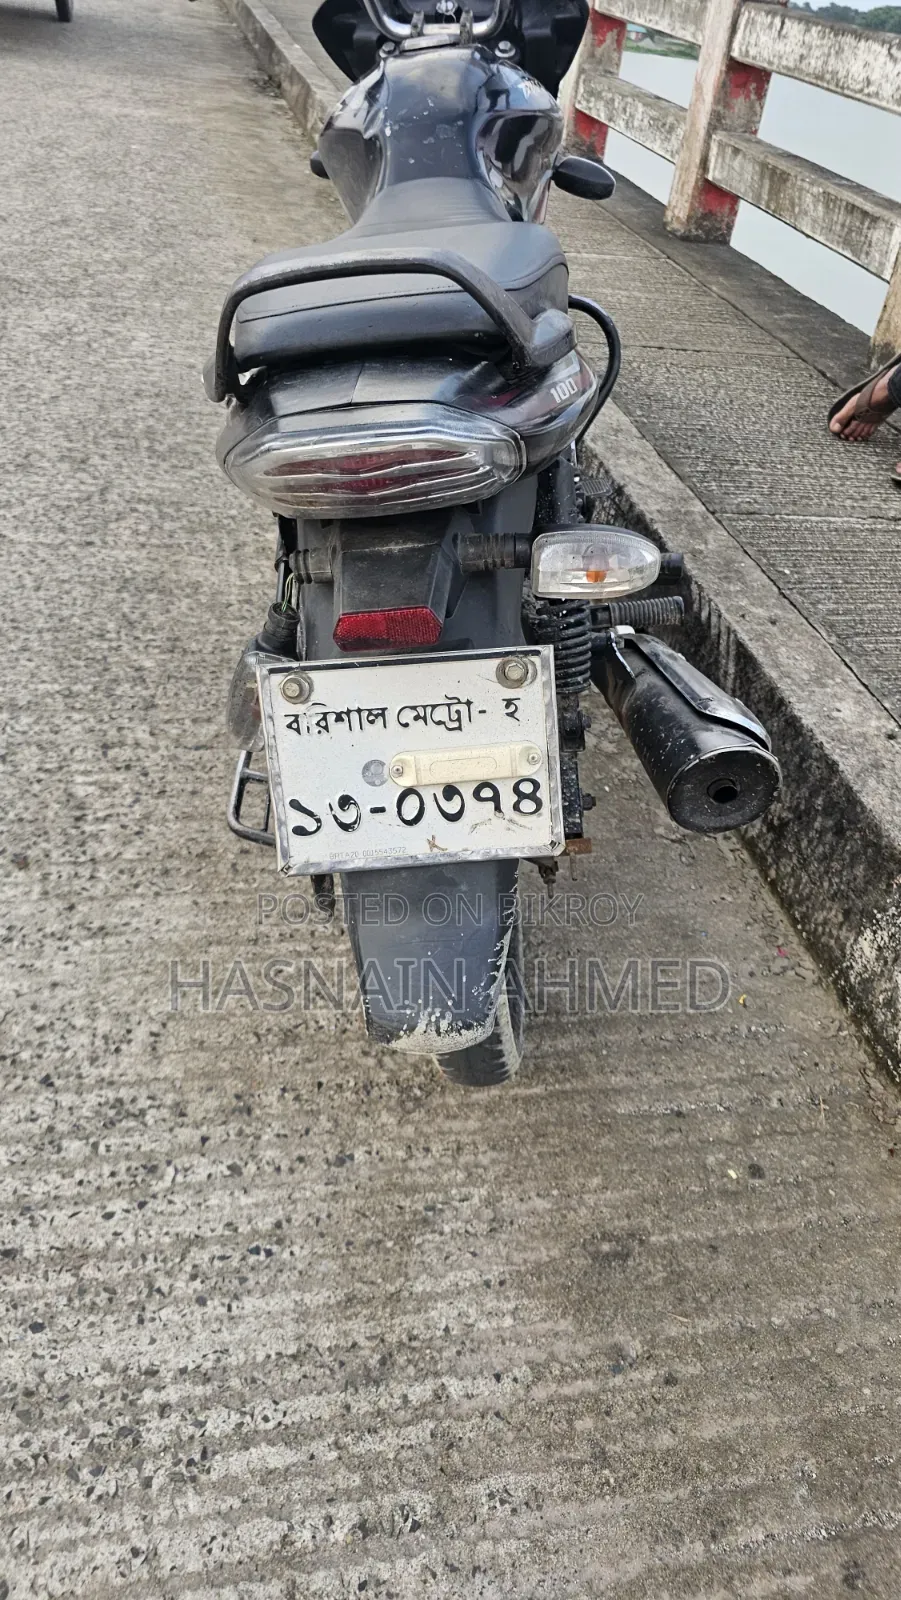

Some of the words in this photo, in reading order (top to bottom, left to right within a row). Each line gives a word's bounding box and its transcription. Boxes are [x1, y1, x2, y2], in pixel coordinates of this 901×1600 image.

[550, 378, 578, 403] 100
[284, 702, 388, 735] বরিশাল
[502, 697, 521, 722] হ
[288, 778, 543, 836] ১৩-০৩৭৪
